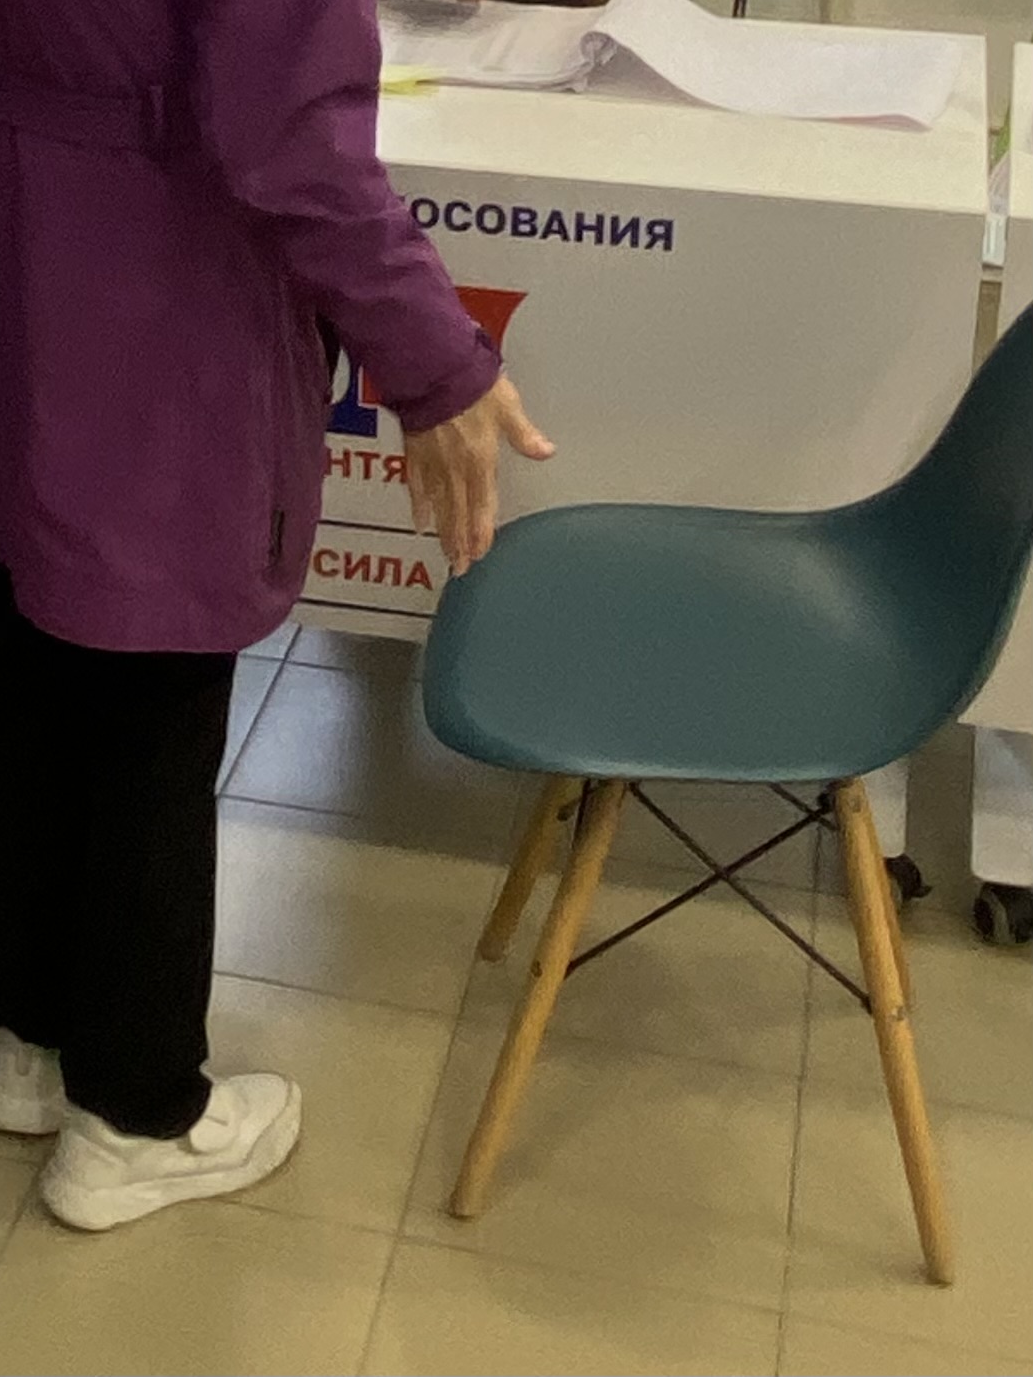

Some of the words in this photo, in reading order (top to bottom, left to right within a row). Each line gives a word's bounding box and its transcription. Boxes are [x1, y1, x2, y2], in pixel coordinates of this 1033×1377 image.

[407, 197, 675, 252] ОСОВАНИЯ
[327, 447, 409, 485] НТЯ
[312, 548, 434, 592] СИЛА
